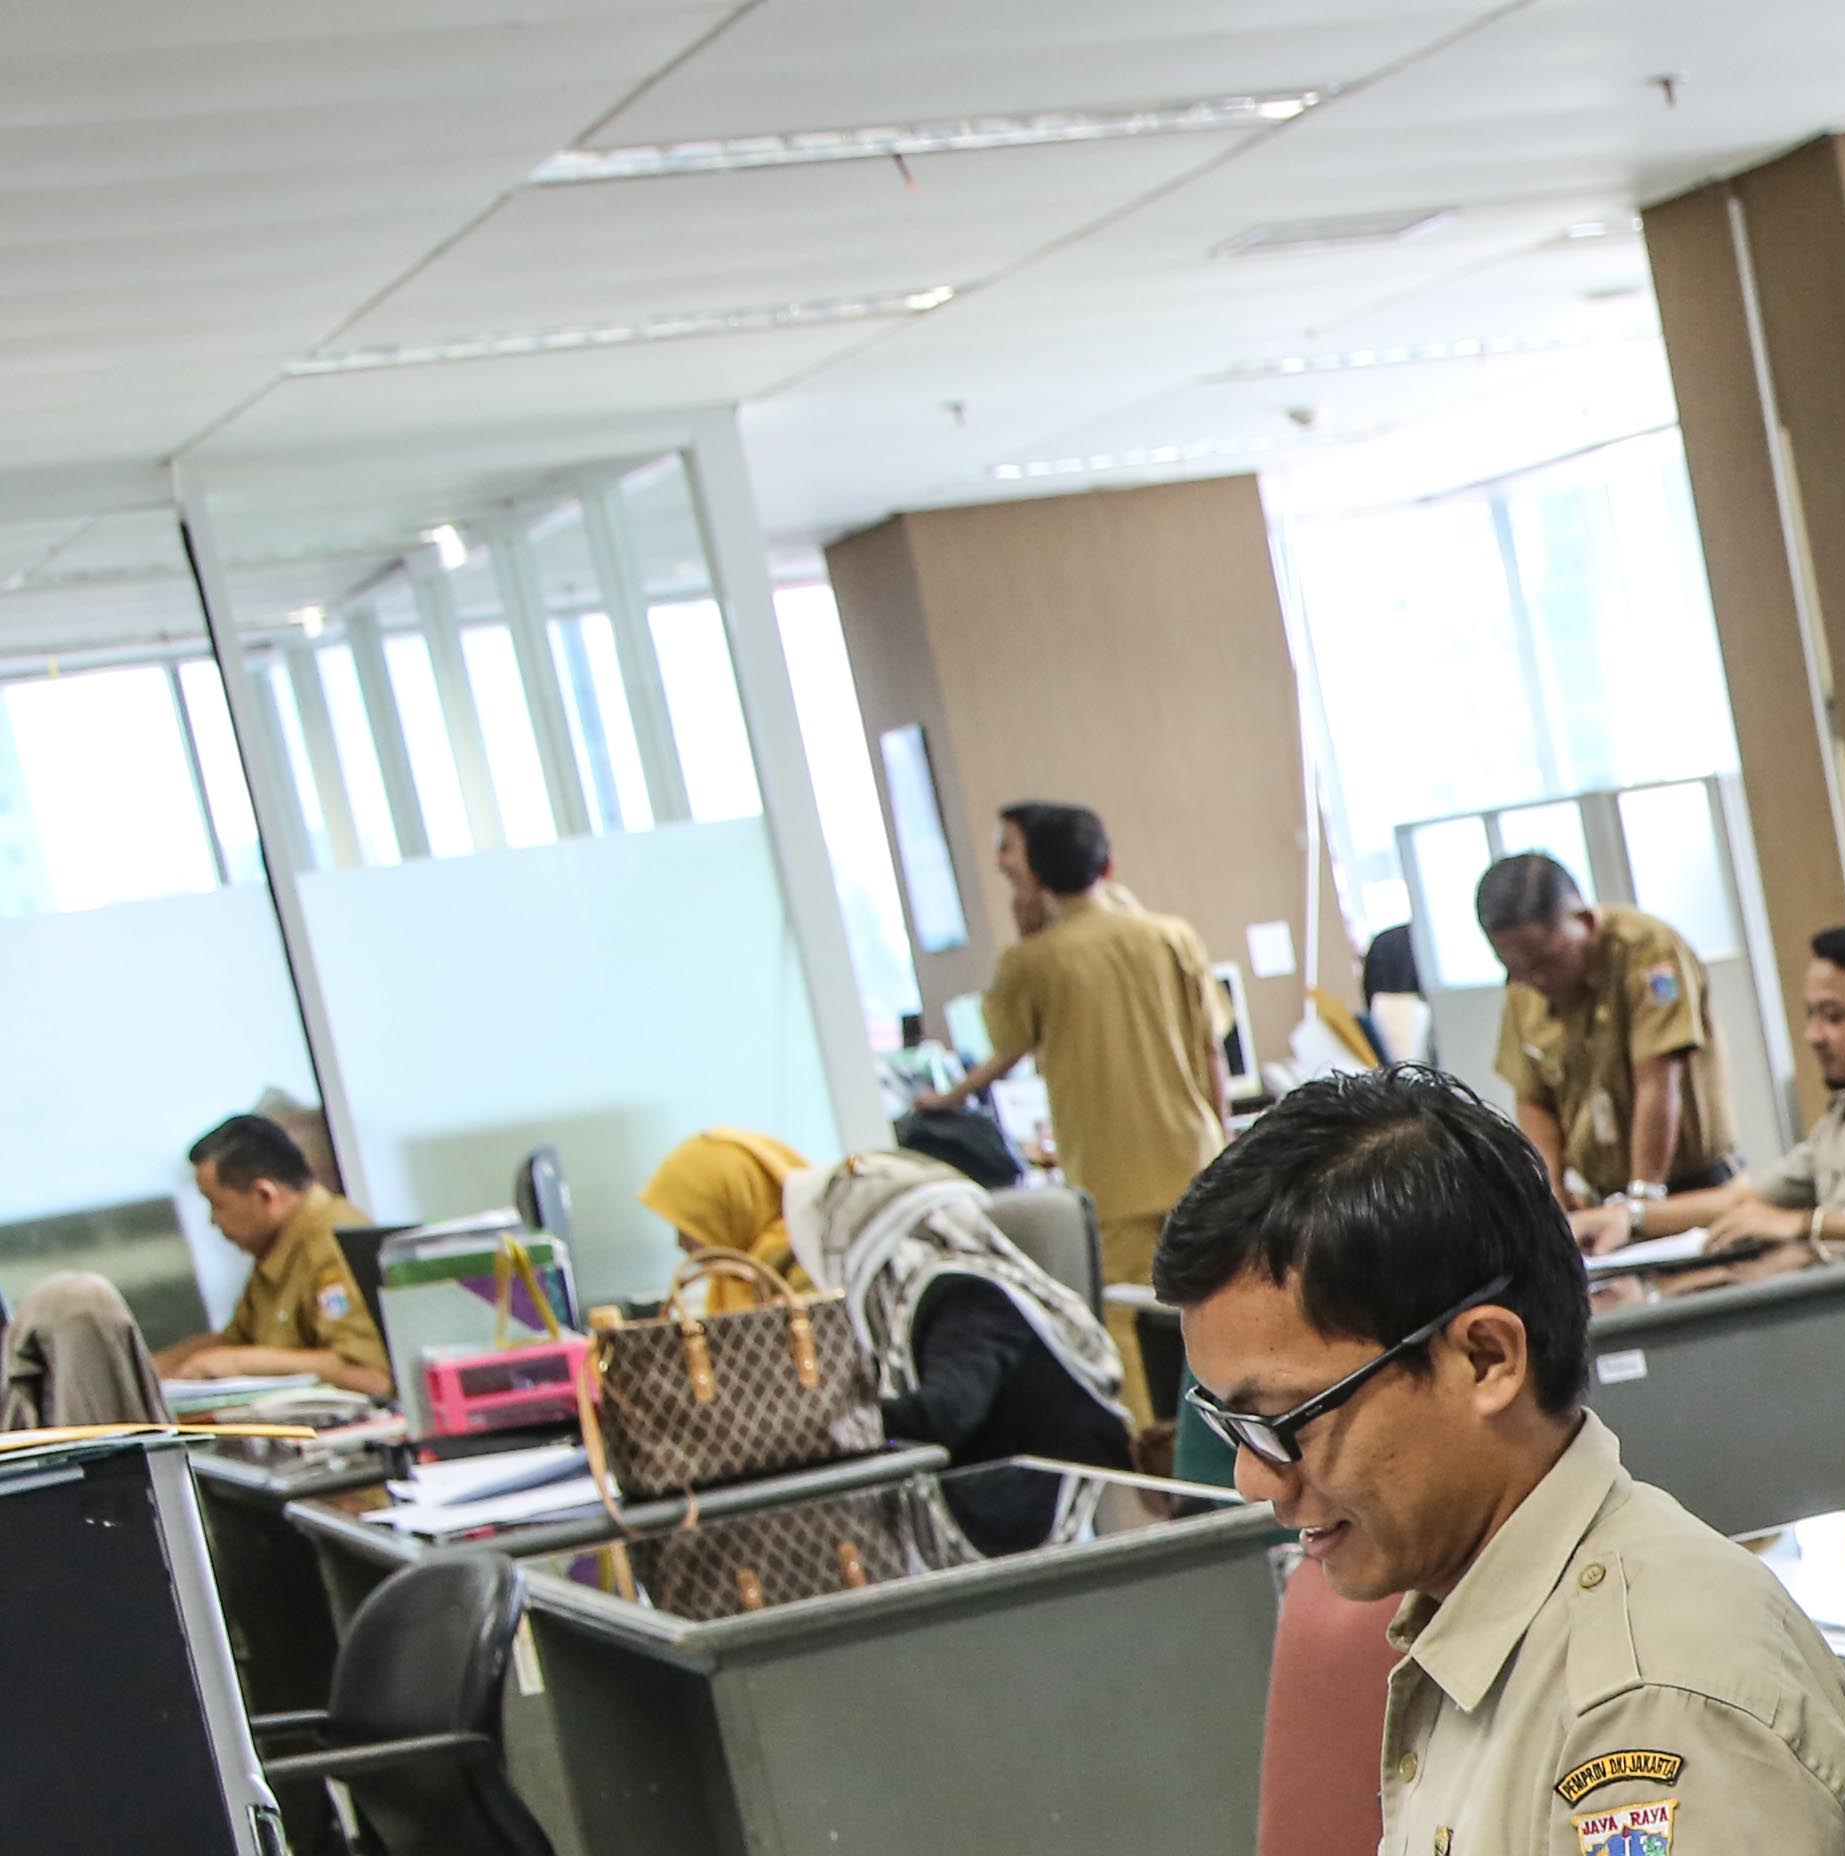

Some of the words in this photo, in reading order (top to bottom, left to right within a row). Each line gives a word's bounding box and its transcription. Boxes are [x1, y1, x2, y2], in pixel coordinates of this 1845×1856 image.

[1562, 1761, 1606, 1798] PEMPROV
[1610, 1757, 1627, 1775] DKI
[1630, 1754, 1677, 1778] JAKARTA
[1583, 1816, 1618, 1835] JAYA
[1630, 1806, 1668, 1826] RAYA
